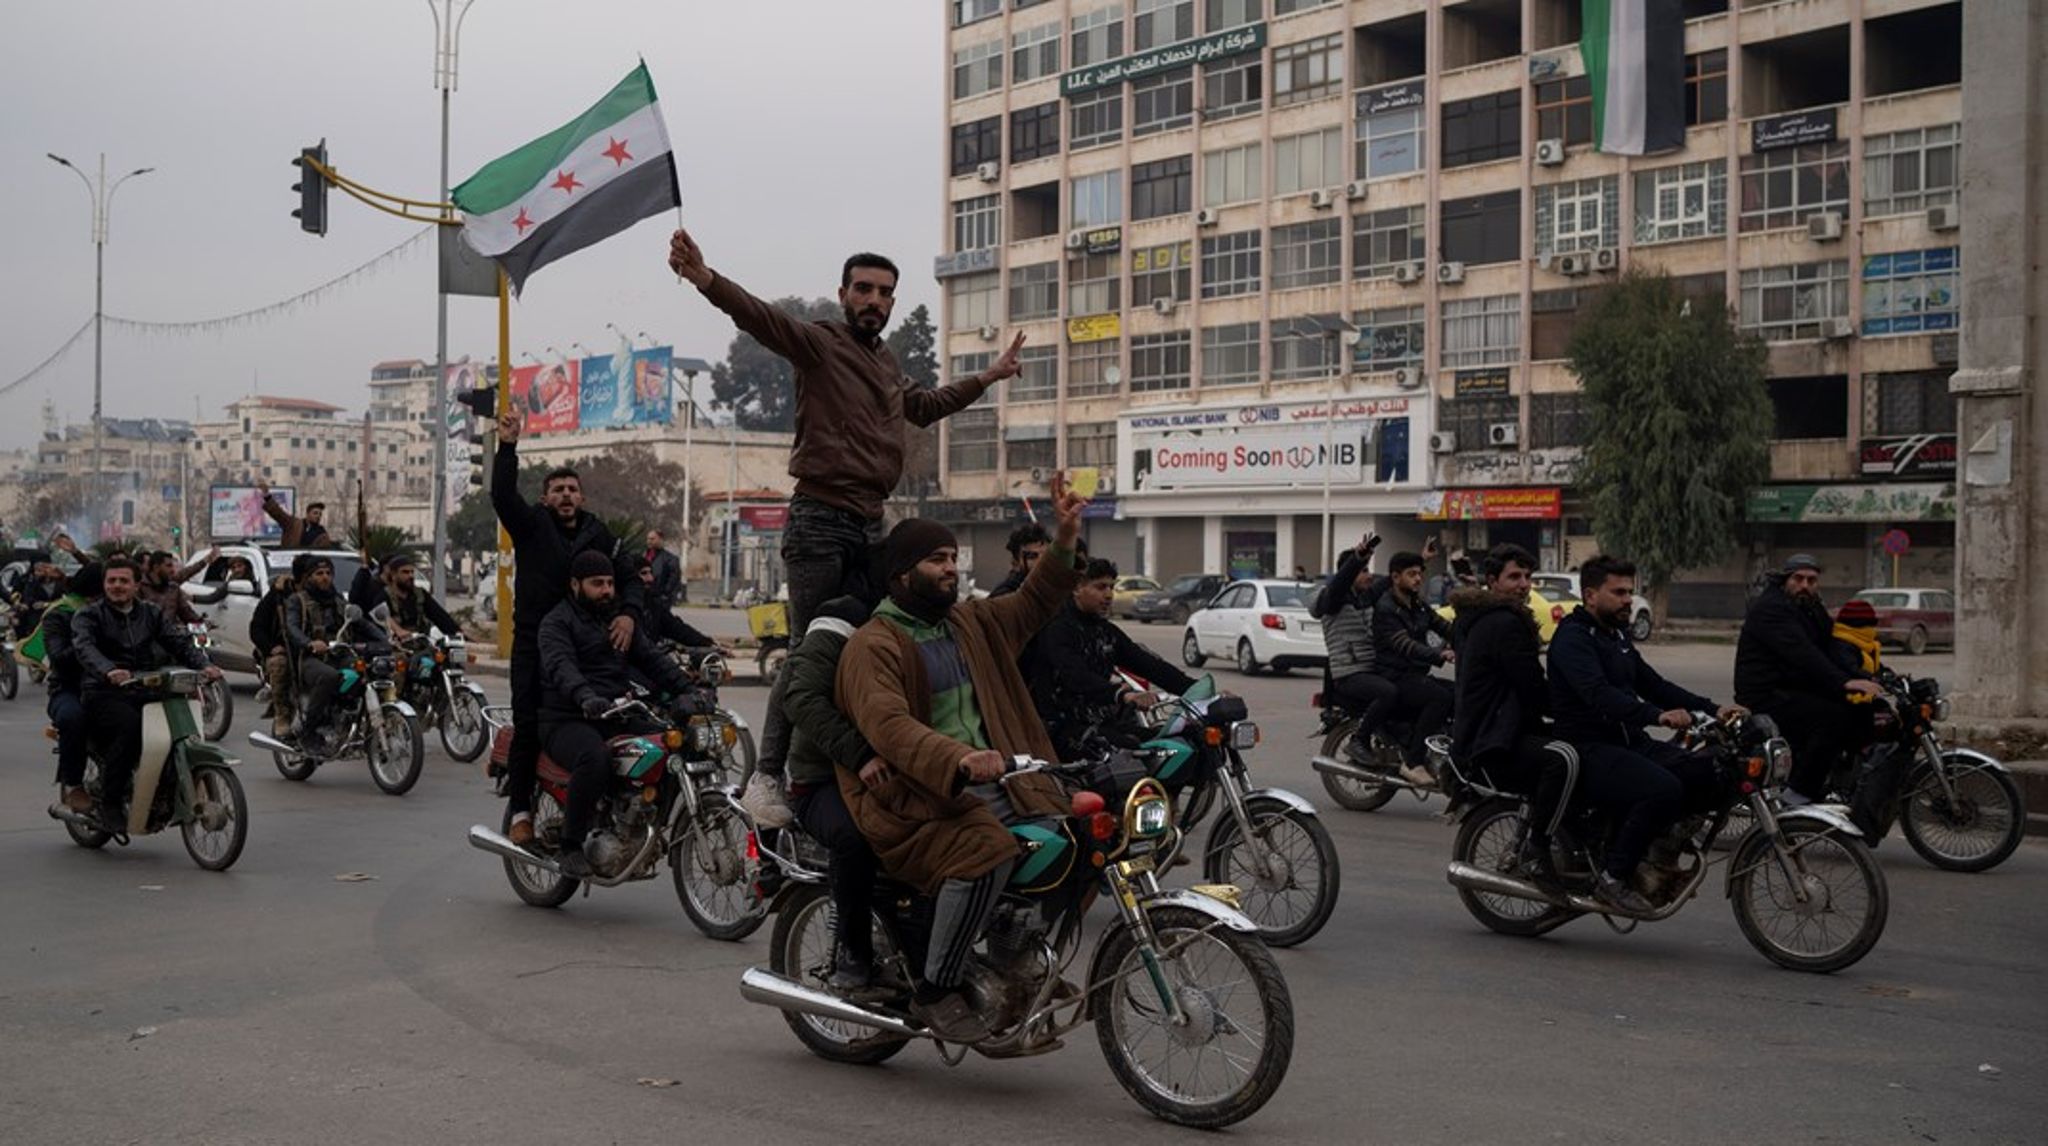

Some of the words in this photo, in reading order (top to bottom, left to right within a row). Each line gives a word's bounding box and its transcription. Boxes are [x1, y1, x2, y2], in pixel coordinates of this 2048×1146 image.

[1131, 416, 1169, 428] NATIONAL
[1171, 414, 1203, 426] ISLAMIC
[1205, 413, 1228, 424] BANK
[1260, 407, 1280, 421] NIB
[1157, 448, 1228, 472] Coming
[1233, 445, 1283, 467] Soon
[1318, 443, 1356, 466] NIB
